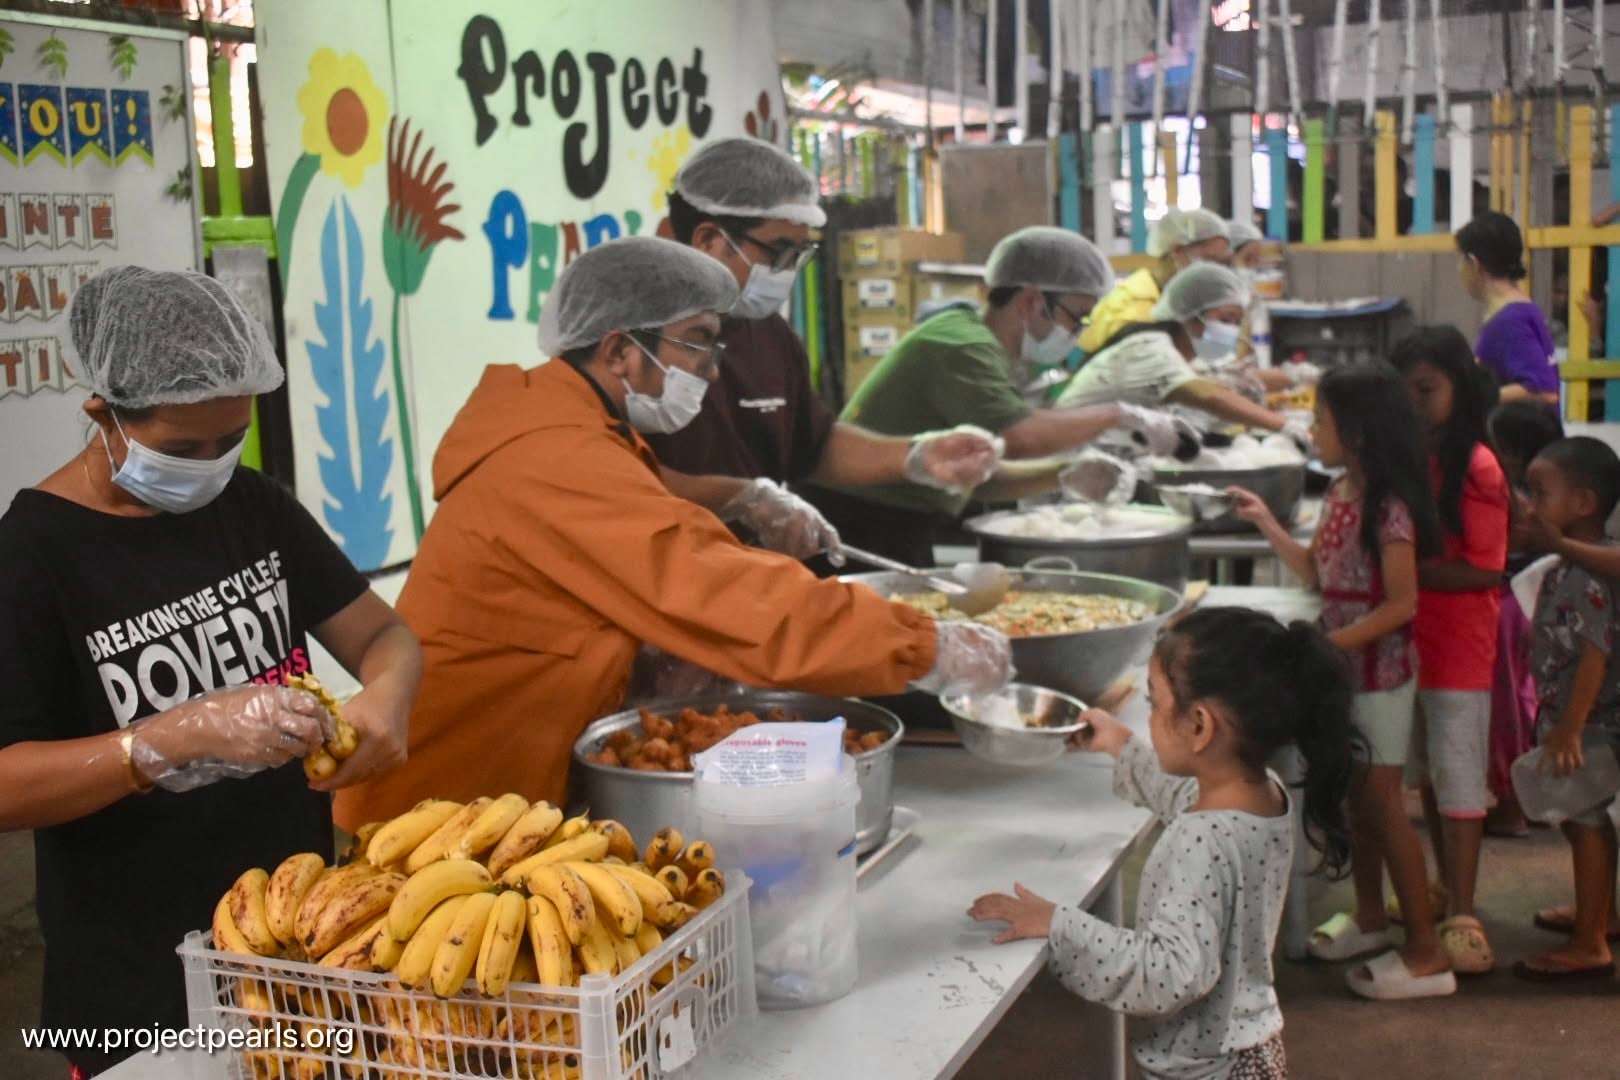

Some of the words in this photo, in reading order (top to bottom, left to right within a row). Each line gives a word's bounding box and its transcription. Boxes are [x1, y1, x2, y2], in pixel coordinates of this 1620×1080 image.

[0, 97, 138, 137] OU!
[86, 601, 188, 662] BREAKING
[180, 586, 224, 621] THE
[218, 559, 275, 605] CYCLE
